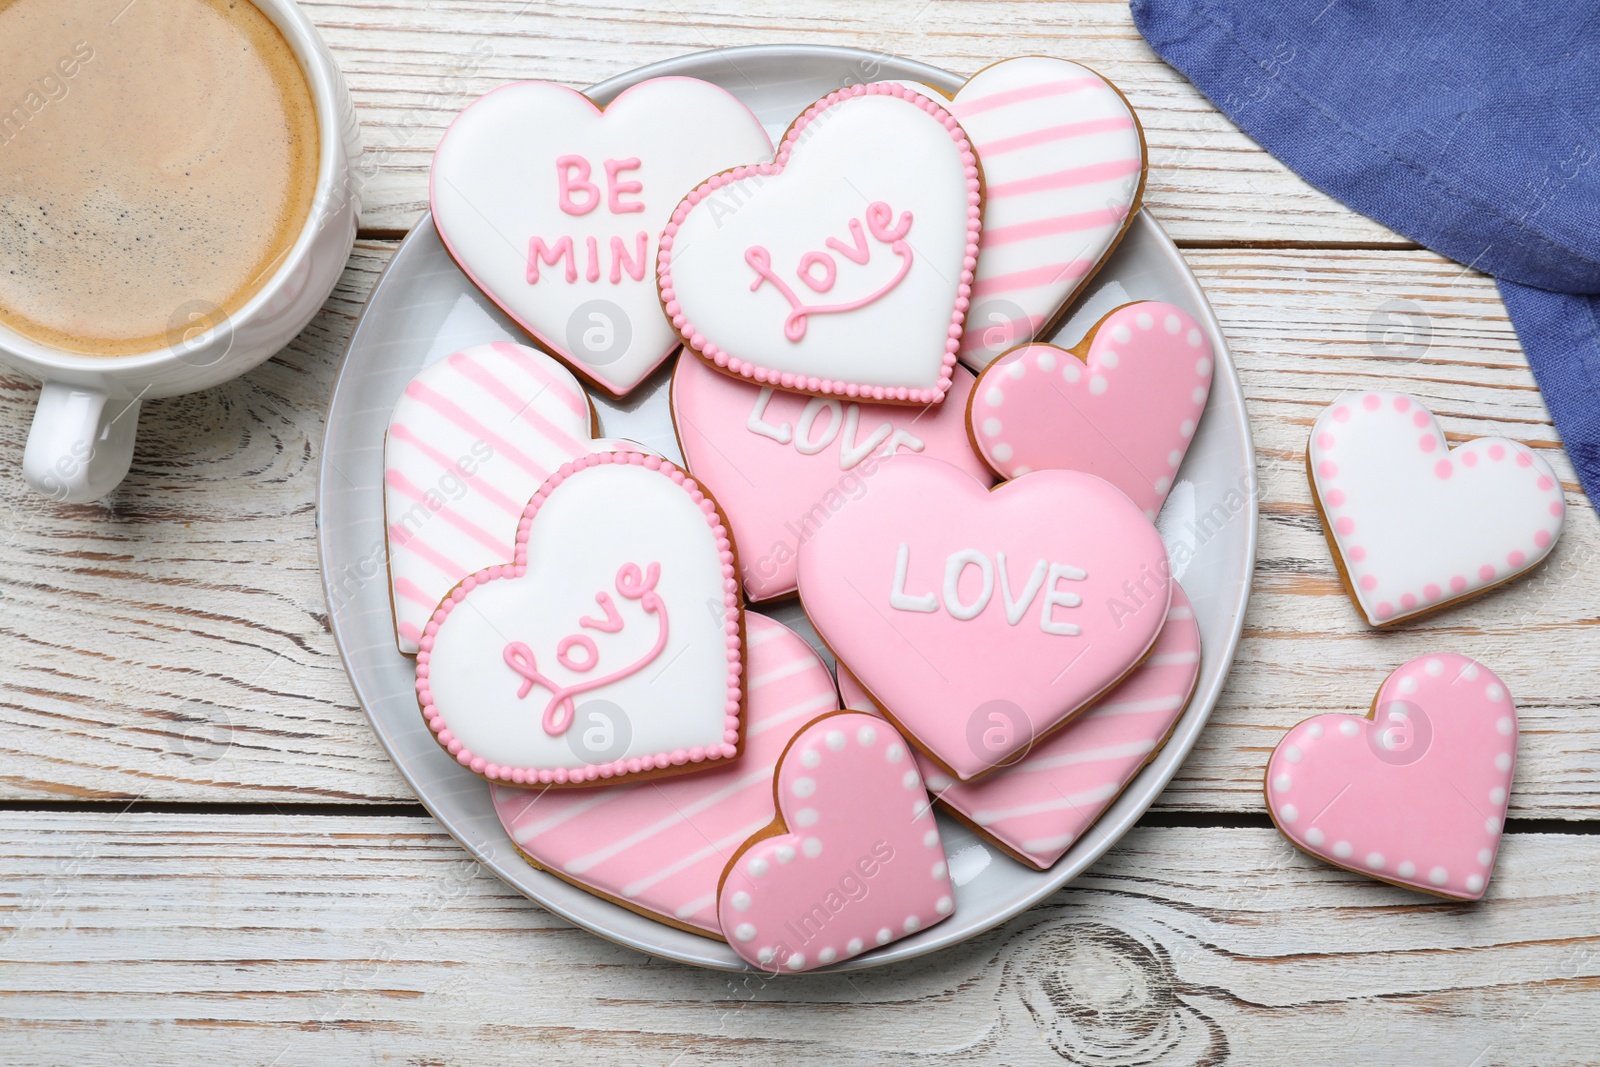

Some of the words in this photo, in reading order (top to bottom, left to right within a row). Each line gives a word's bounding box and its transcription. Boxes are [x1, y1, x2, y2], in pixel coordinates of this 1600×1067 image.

[556, 154, 645, 216] BE
[526, 231, 663, 286] MIN
[744, 200, 914, 344] Love
[889, 542, 1088, 637] LOVE
[502, 561, 669, 738] Love
